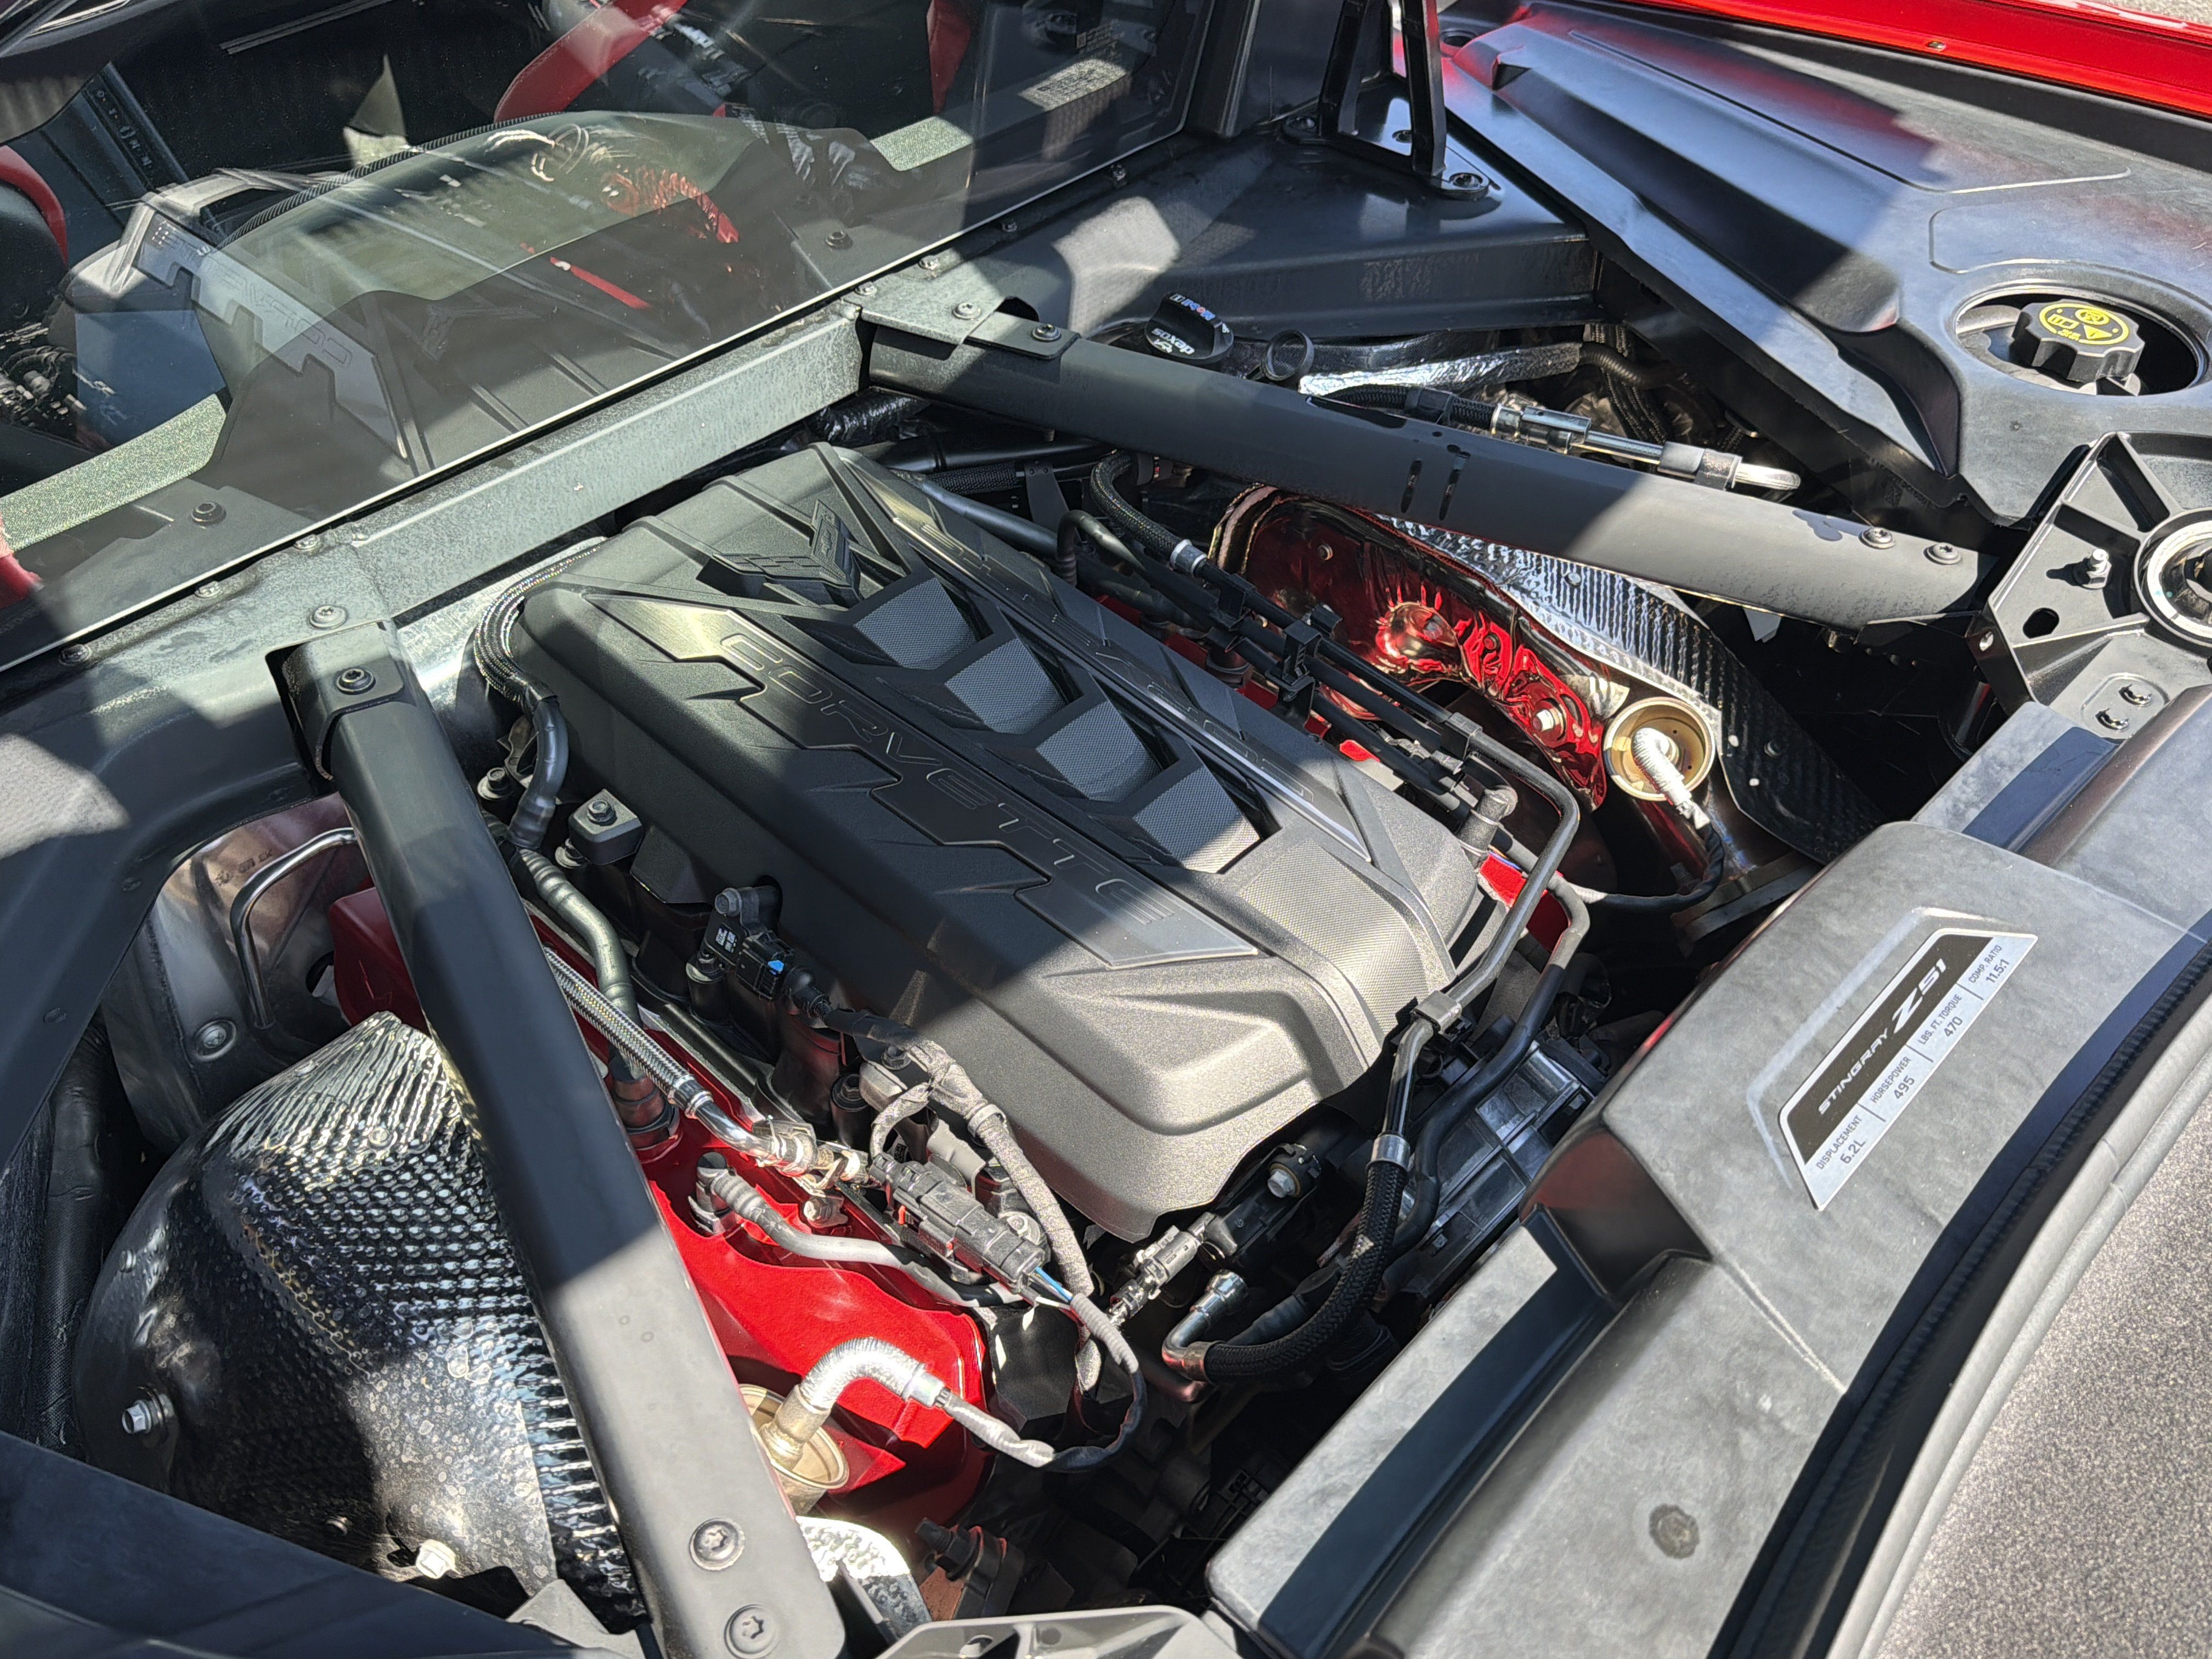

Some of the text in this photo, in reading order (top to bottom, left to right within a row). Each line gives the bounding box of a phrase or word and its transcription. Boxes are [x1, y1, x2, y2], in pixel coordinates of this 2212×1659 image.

[1152, 328, 1195, 355] dexos
[719, 633, 1174, 926] CORVETTE
[1968, 944, 2002, 984] COMP. RATIO
[1985, 958, 2010, 983] 11.5:1
[1818, 958, 1946, 1115] STINGRAY Z51
[1918, 994, 1962, 1045] LBS. FT. TORQUE
[1943, 1016, 1963, 1037] 470
[1870, 1056, 1911, 1104] HORSEPOWER
[1893, 1075, 1915, 1099] 495
[1816, 1115, 1863, 1170] DISPLACEMENT
[1839, 1140, 1866, 1164] 6.2L
